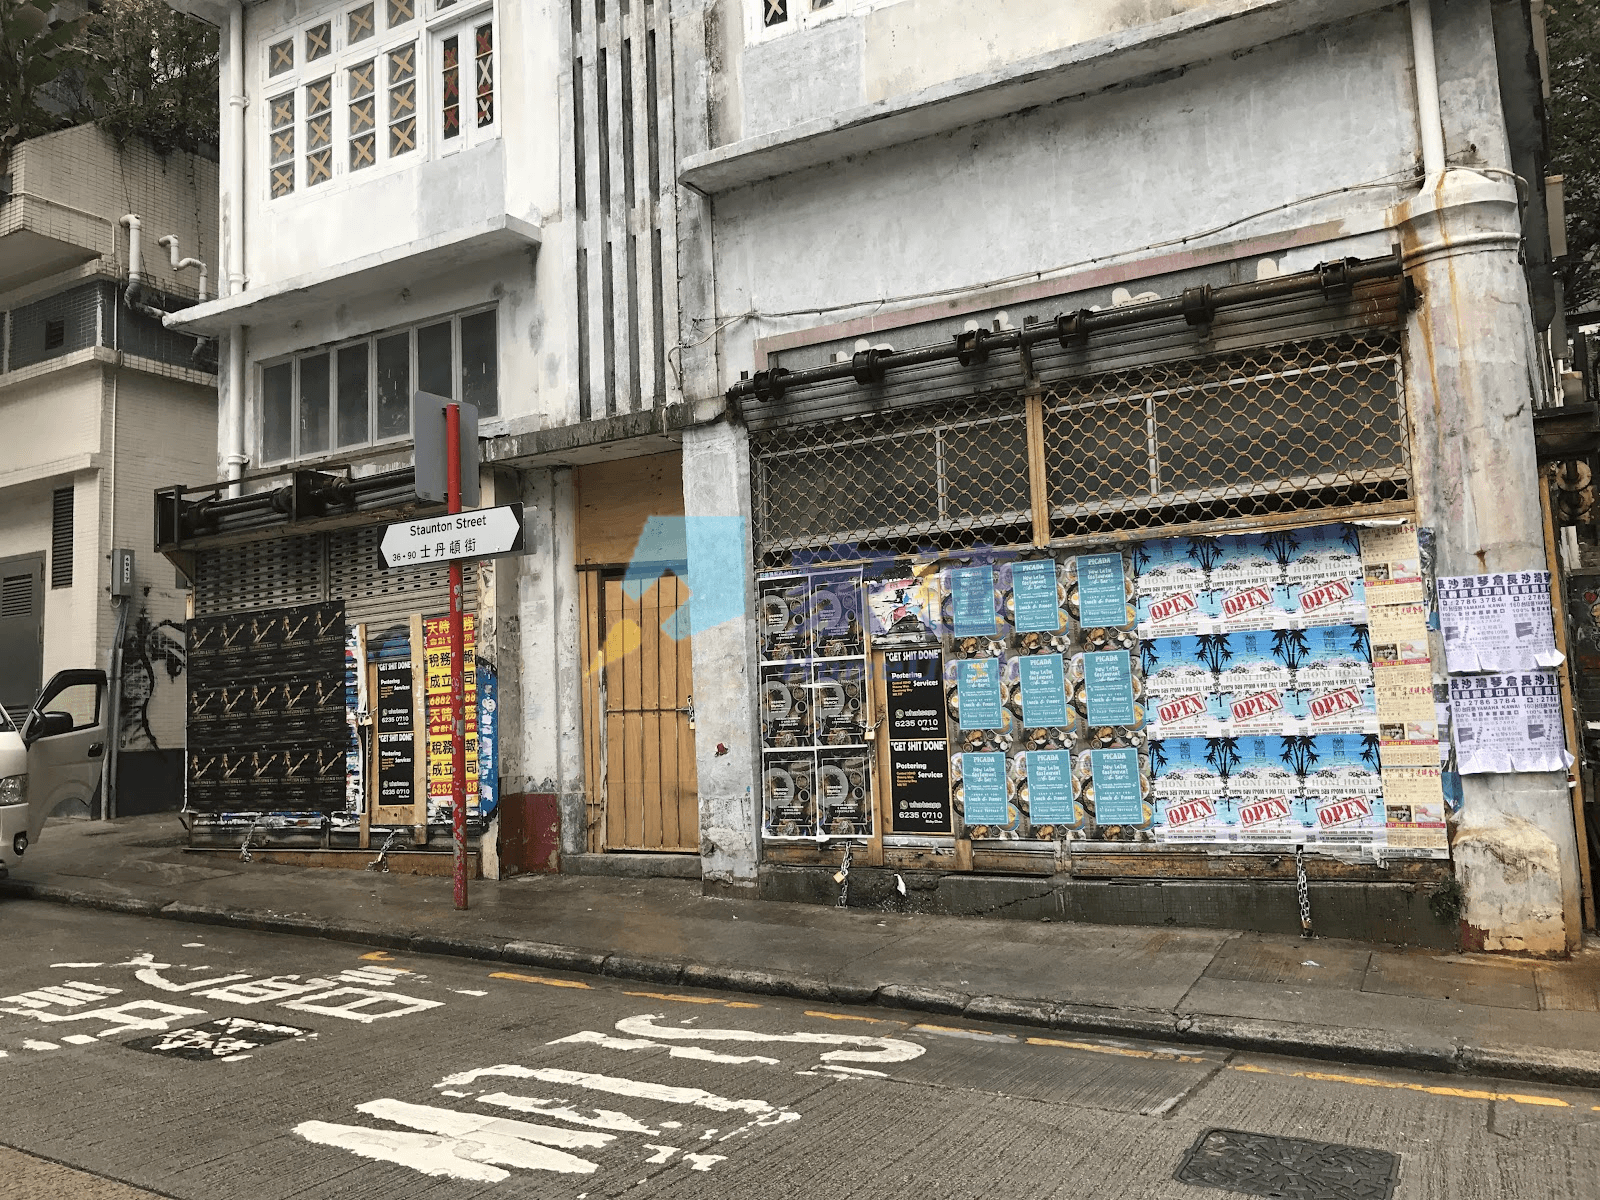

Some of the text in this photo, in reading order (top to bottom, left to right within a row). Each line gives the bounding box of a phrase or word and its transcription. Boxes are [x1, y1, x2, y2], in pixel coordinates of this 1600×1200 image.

[410, 515, 487, 536] Staunton Street
[420, 538, 476, 559] 士丹頓街
[1217, 568, 1273, 579] HONI HONI
[1293, 561, 1353, 573] HONI HONI
[1144, 575, 1197, 585] HONI HONI
[1224, 587, 1269, 614] OPEN
[1302, 580, 1349, 610] OPEN
[1151, 593, 1194, 619] OPEN
[886, 652, 901, 662] "GET
[902, 651, 917, 661] SHIT
[1152, 676, 1206, 686] HONI HONI
[1256, 672, 1282, 680] HONI
[1303, 669, 1363, 679] HONI HONI
[1160, 695, 1203, 722] OPEN
[1233, 692, 1279, 719] OPEN
[1311, 690, 1359, 717] OPEN
[890, 742, 906, 751] "GET
[908, 741, 922, 751] SHIT
[1161, 780, 1186, 788] HONI
[1264, 778, 1292, 786] HONI
[1312, 778, 1372, 787] HONI HONI
[1169, 800, 1212, 824] OPEN
[1242, 800, 1287, 824] OPEN
[1320, 800, 1368, 825] OPEN
